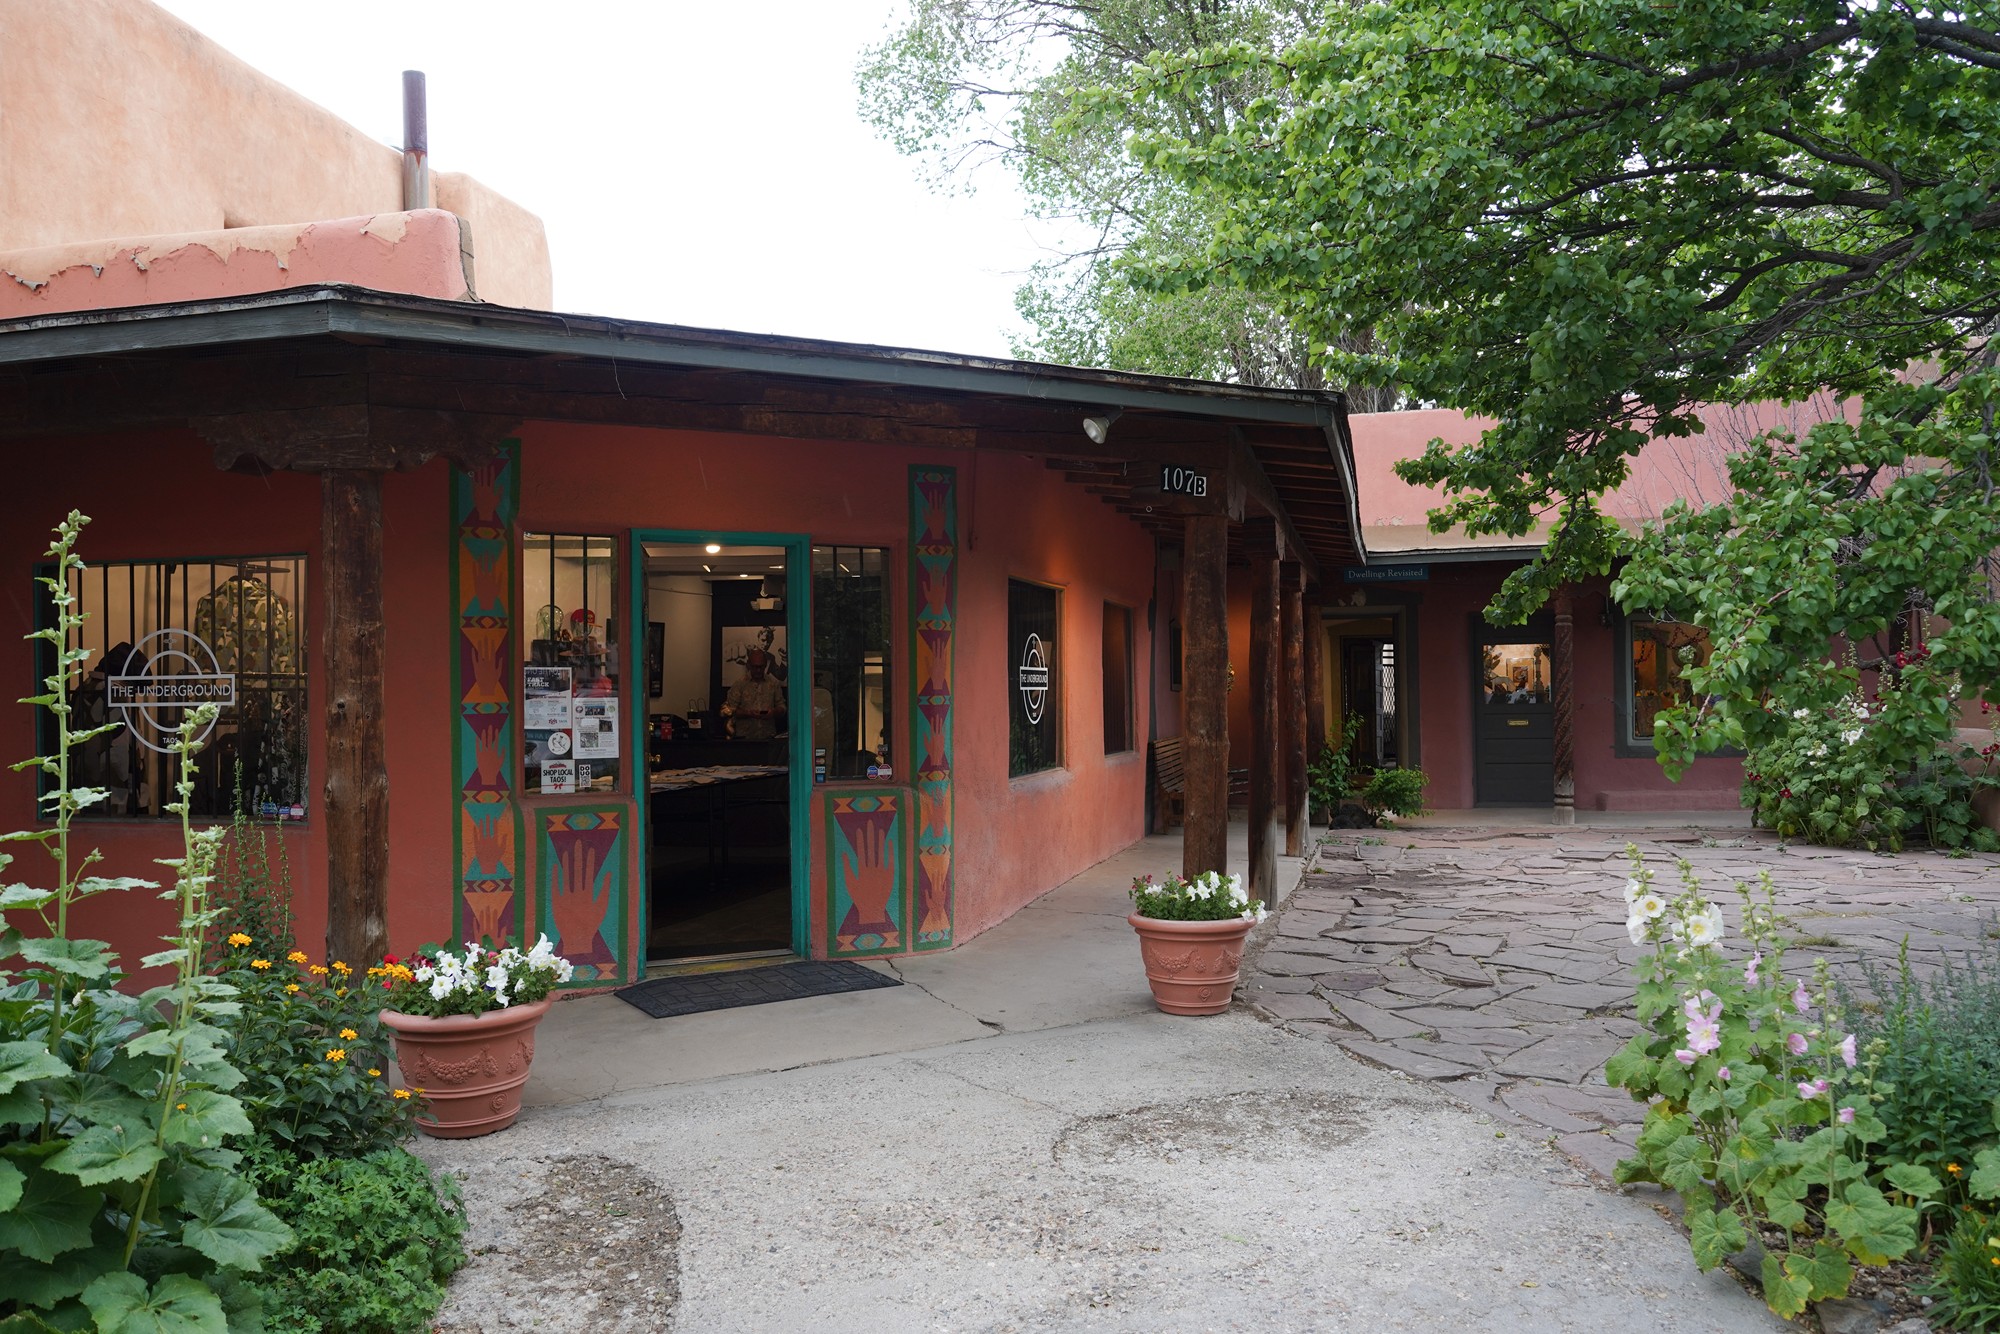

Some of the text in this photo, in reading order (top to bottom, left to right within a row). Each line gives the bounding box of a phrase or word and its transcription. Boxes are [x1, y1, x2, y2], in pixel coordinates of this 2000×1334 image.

[1348, 568, 1423, 579] Dwellings Revisited
[112, 684, 231, 697] THE UNDERGROUND
[543, 769, 558, 777] SHOP
